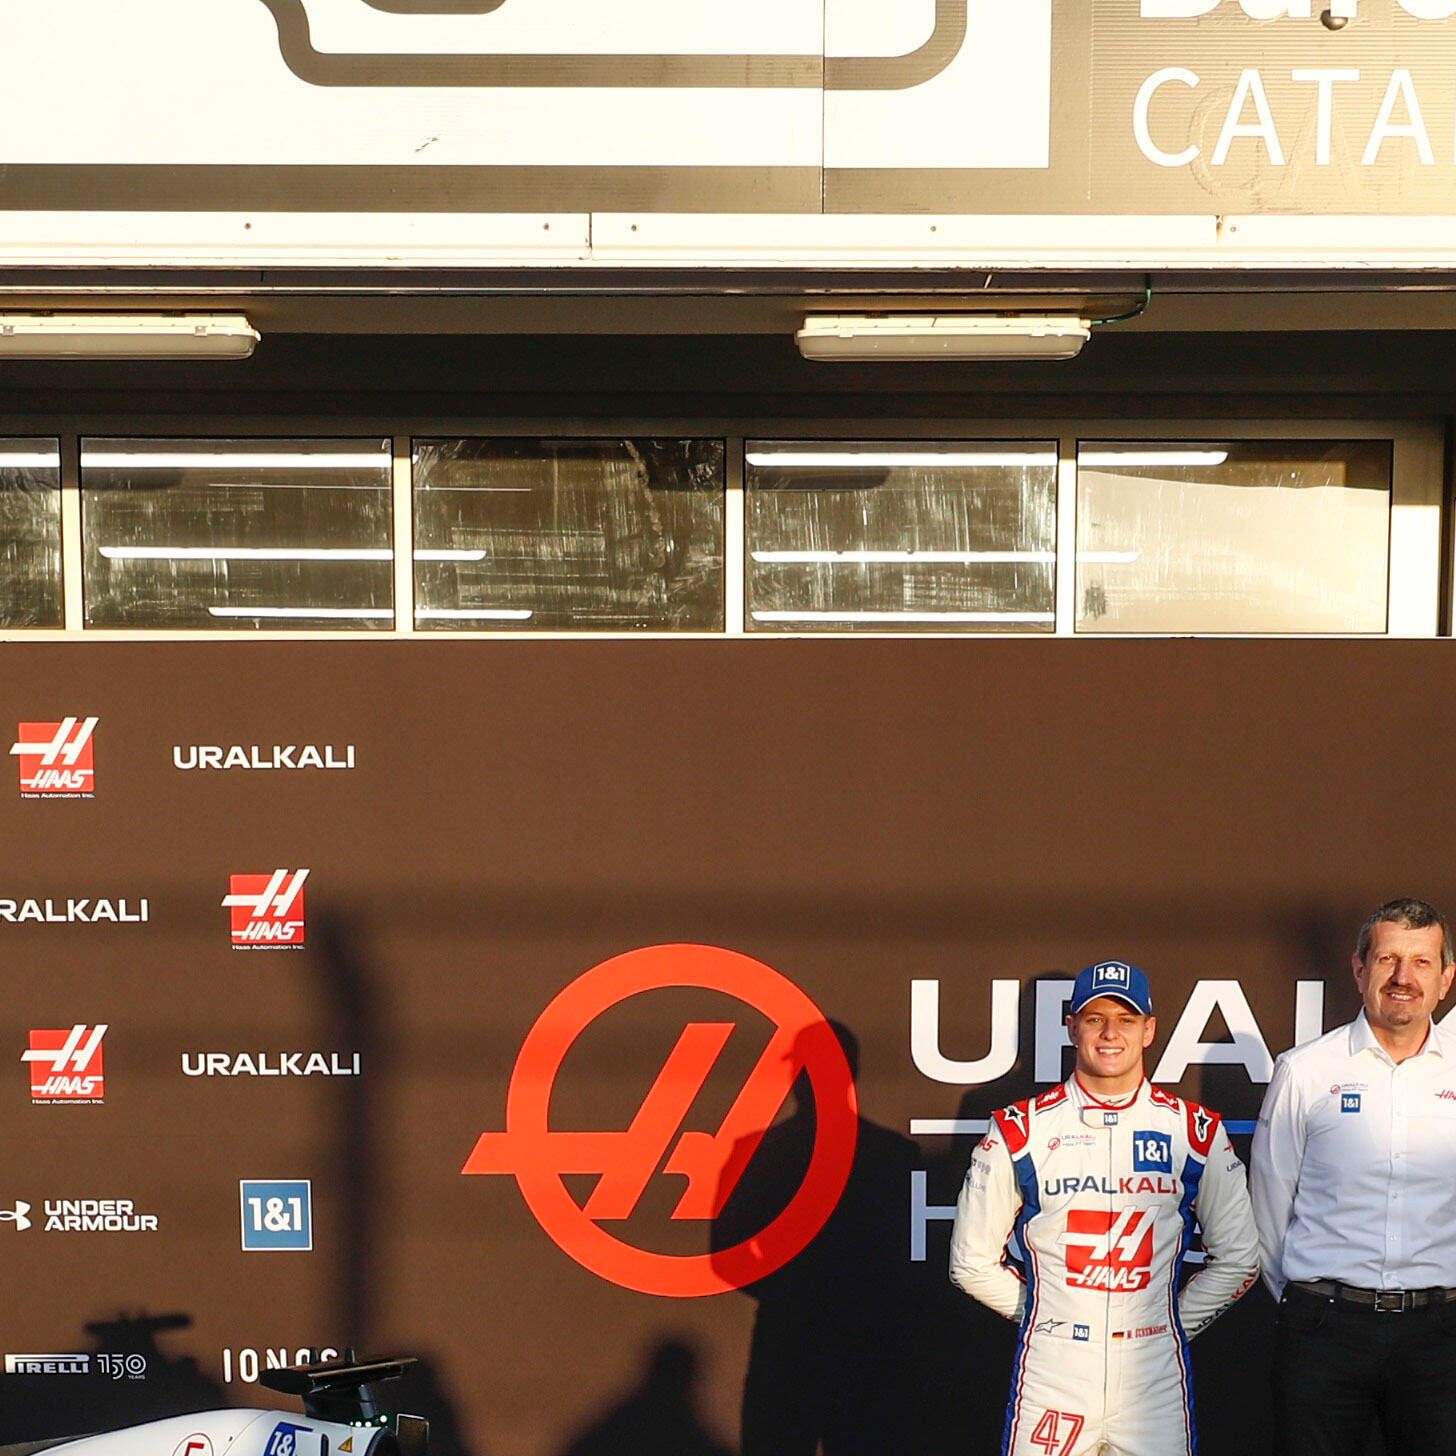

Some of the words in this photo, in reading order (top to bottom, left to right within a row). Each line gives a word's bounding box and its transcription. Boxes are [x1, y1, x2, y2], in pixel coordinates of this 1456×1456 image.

[174, 746, 354, 769] URALKALI
[21, 770, 94, 789] HAAS
[232, 922, 304, 940] HAAS
[1097, 967, 1125, 981] 1&1
[182, 1054, 359, 1075] URALKALI
[32, 1077, 104, 1095] HAAS
[1343, 1098, 1359, 1108] 1&1
[1135, 1139, 1169, 1163] 1&1
[1045, 1177, 1177, 1195] URALKALI
[45, 1201, 133, 1216] UNDER
[249, 1198, 301, 1231] 1&1
[46, 1215, 157, 1231] ARMOUR
[1066, 1266, 1152, 1289] HAAS
[5, 1354, 90, 1374] PIRELLI
[1030, 1408, 1085, 1456] 47
